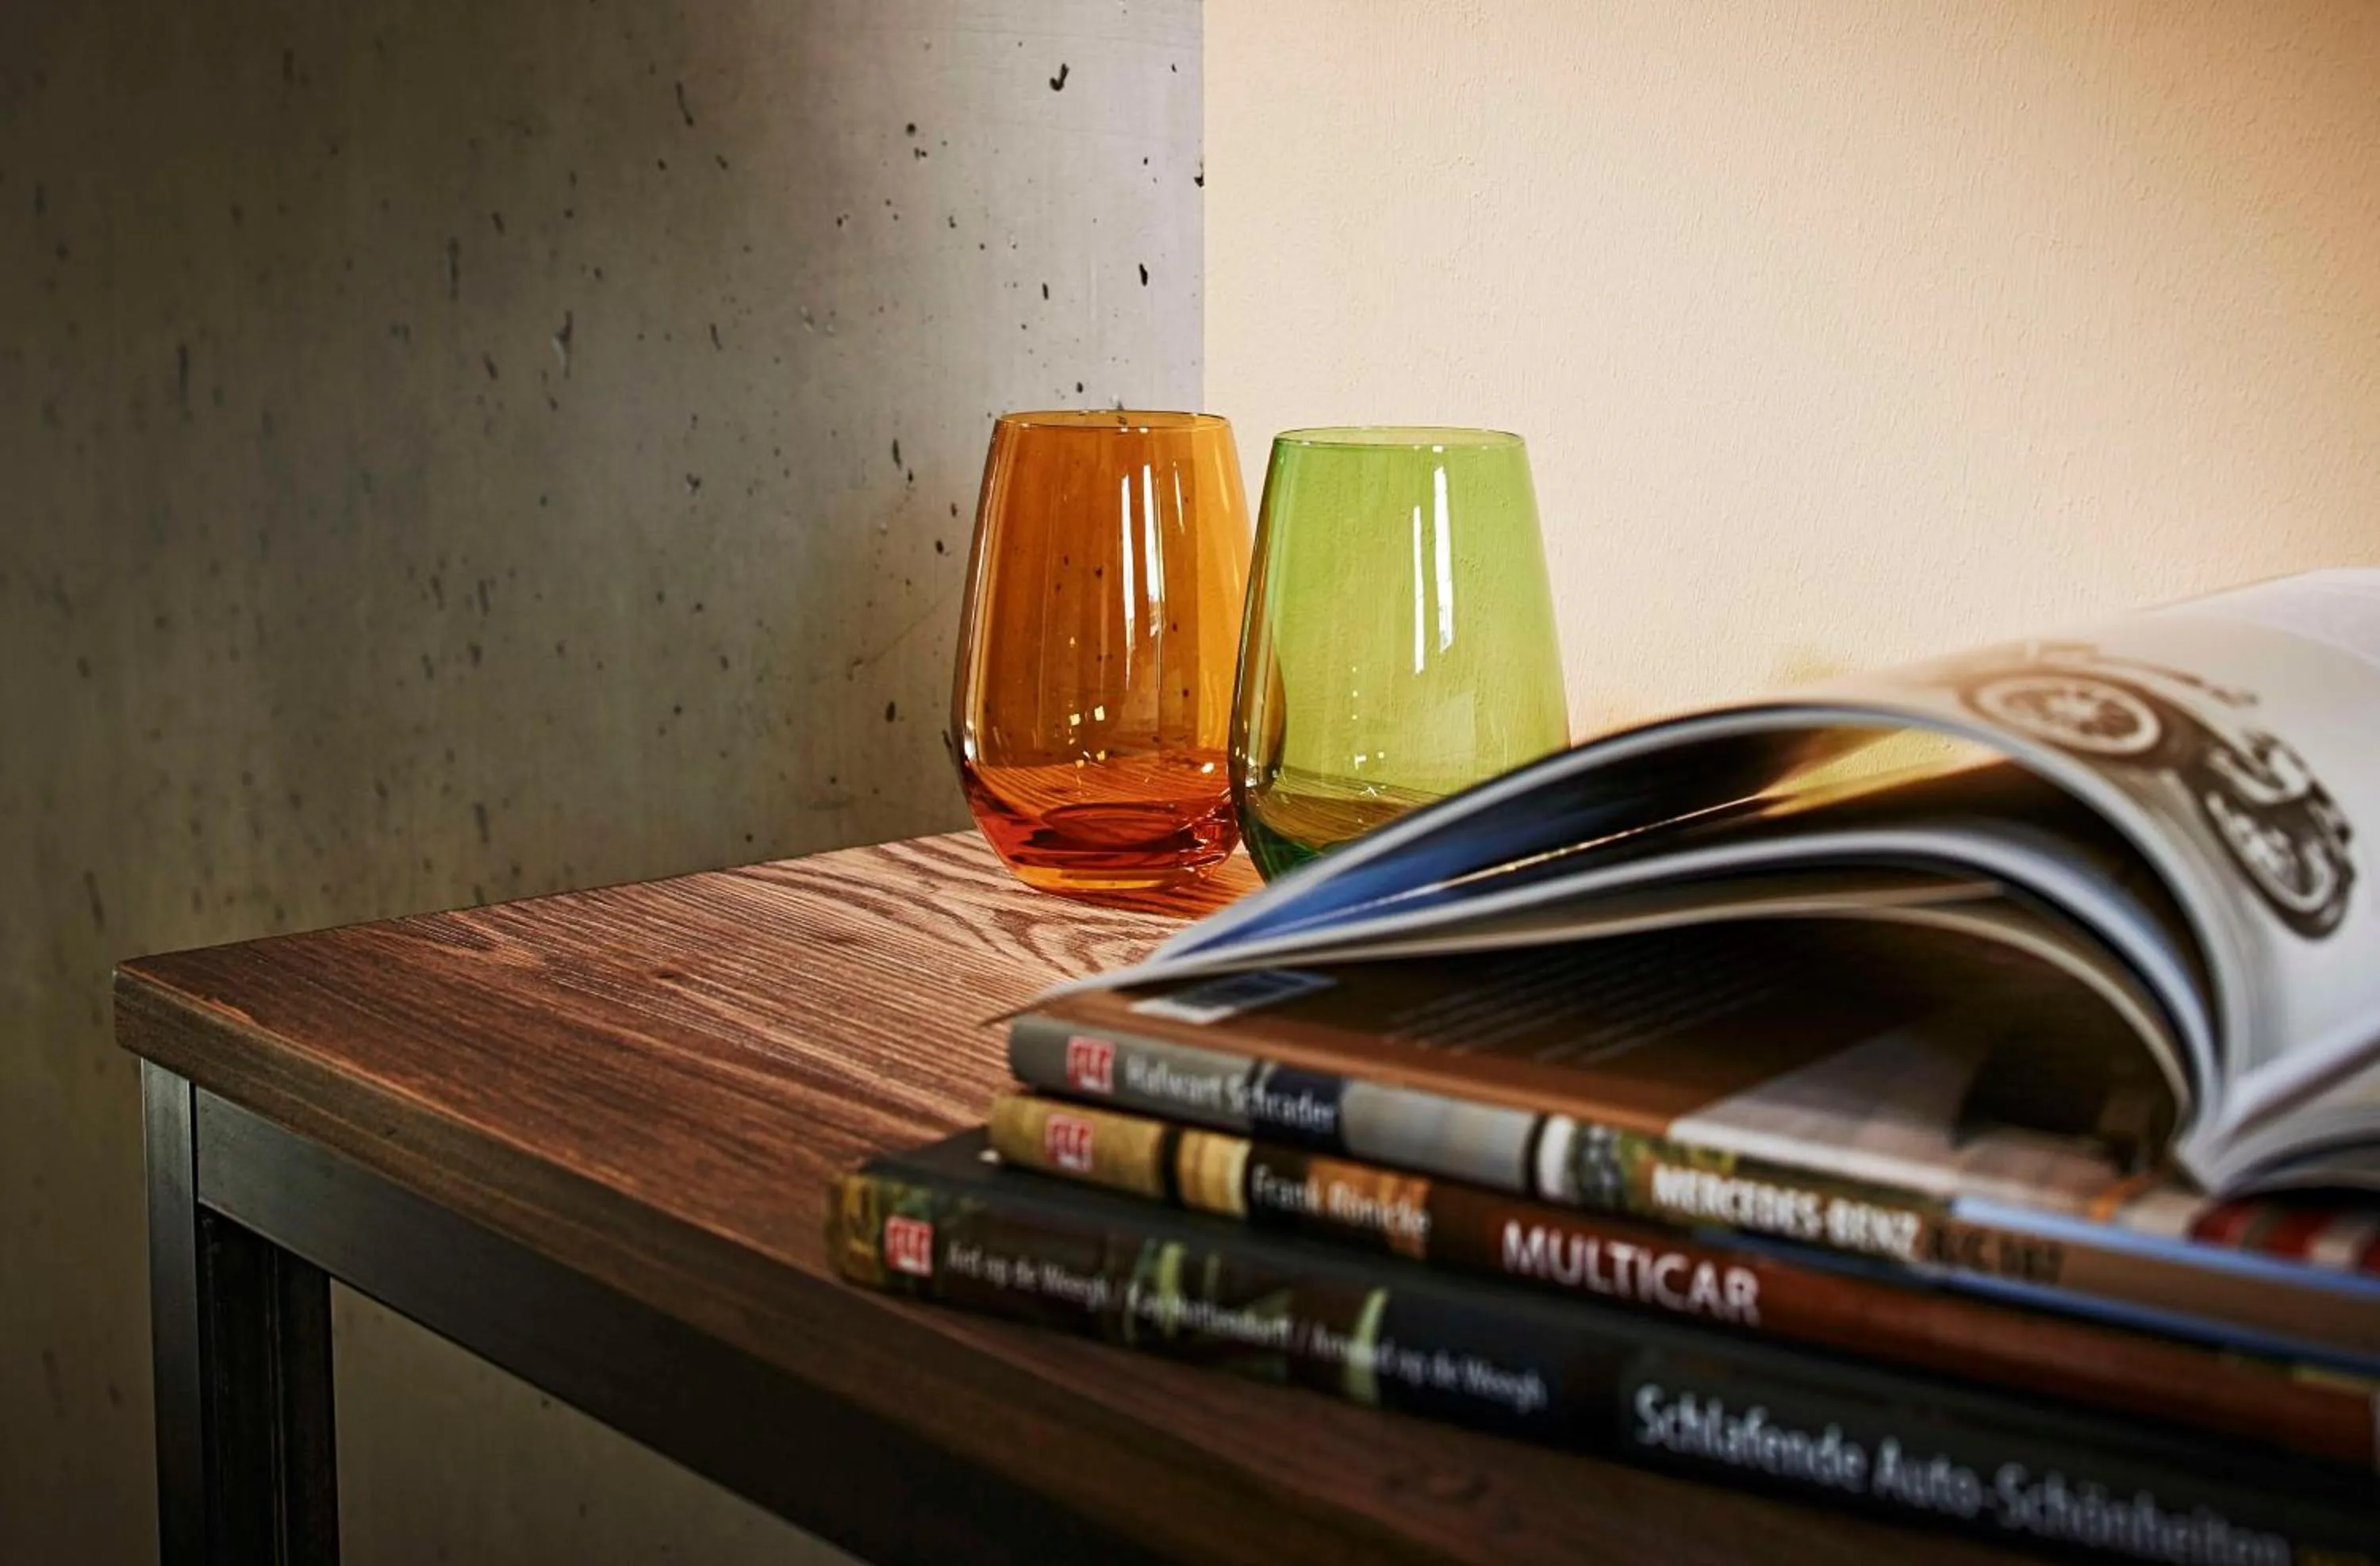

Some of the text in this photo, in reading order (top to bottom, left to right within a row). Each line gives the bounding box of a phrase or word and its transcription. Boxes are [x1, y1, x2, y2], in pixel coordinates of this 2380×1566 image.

[1652, 1161, 1920, 1261] MERCEDES-BENZ
[1502, 1219, 1761, 1328] MULTICAR
[1632, 1382, 1869, 1495] Schlafende
